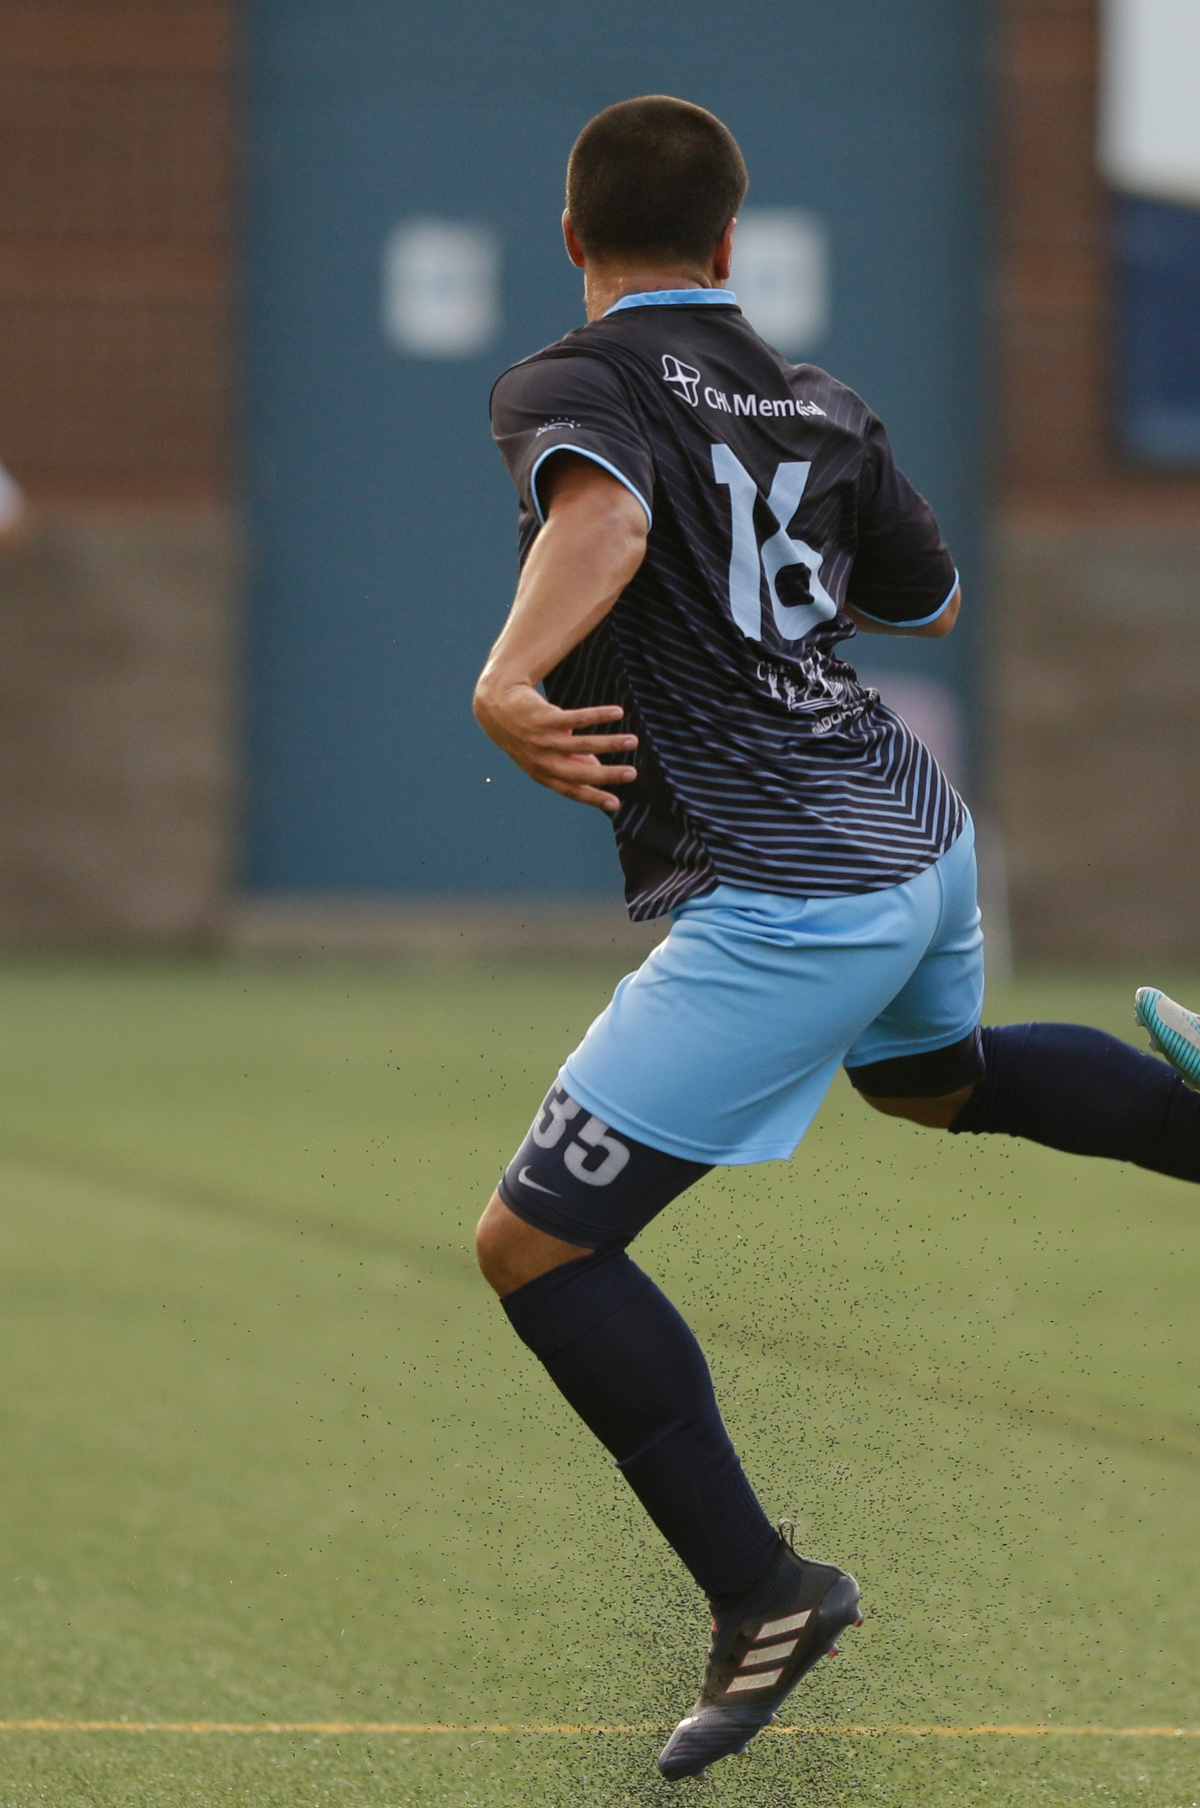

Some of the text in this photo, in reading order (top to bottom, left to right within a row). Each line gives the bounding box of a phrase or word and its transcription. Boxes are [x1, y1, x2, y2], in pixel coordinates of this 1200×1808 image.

[703, 386, 732, 414] CHI
[710, 443, 837, 642] 16
[532, 1081, 631, 1187] 35
